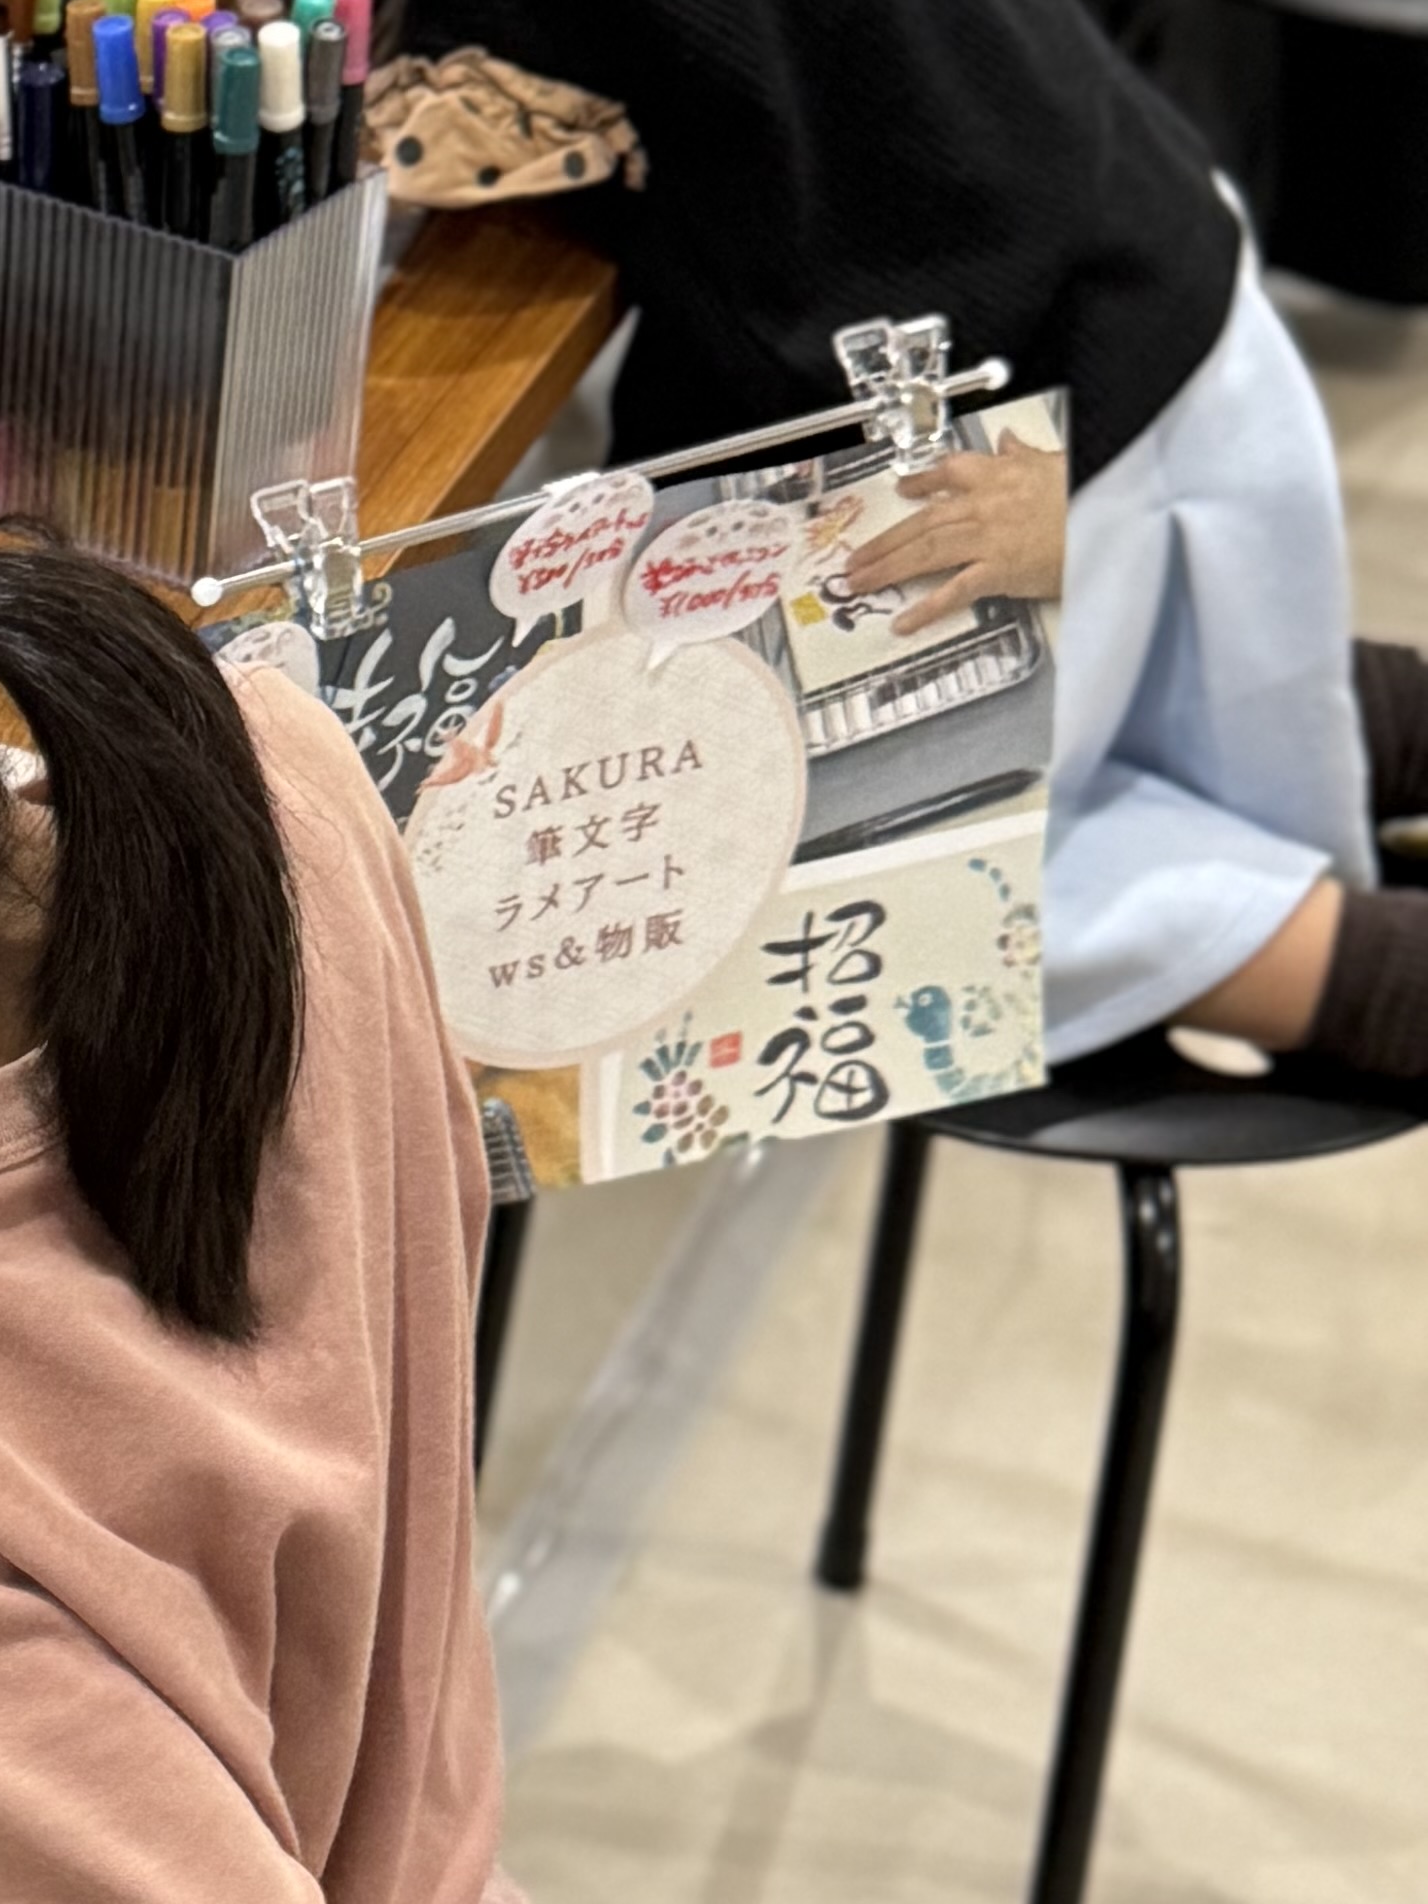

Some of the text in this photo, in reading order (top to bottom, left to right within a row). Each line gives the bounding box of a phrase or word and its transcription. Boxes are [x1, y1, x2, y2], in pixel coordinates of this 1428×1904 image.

[494, 739, 703, 820] SAKURA
[526, 801, 662, 867] 筆文字
[494, 854, 685, 933] ラメアート
[753, 900, 890, 1124] 招福
